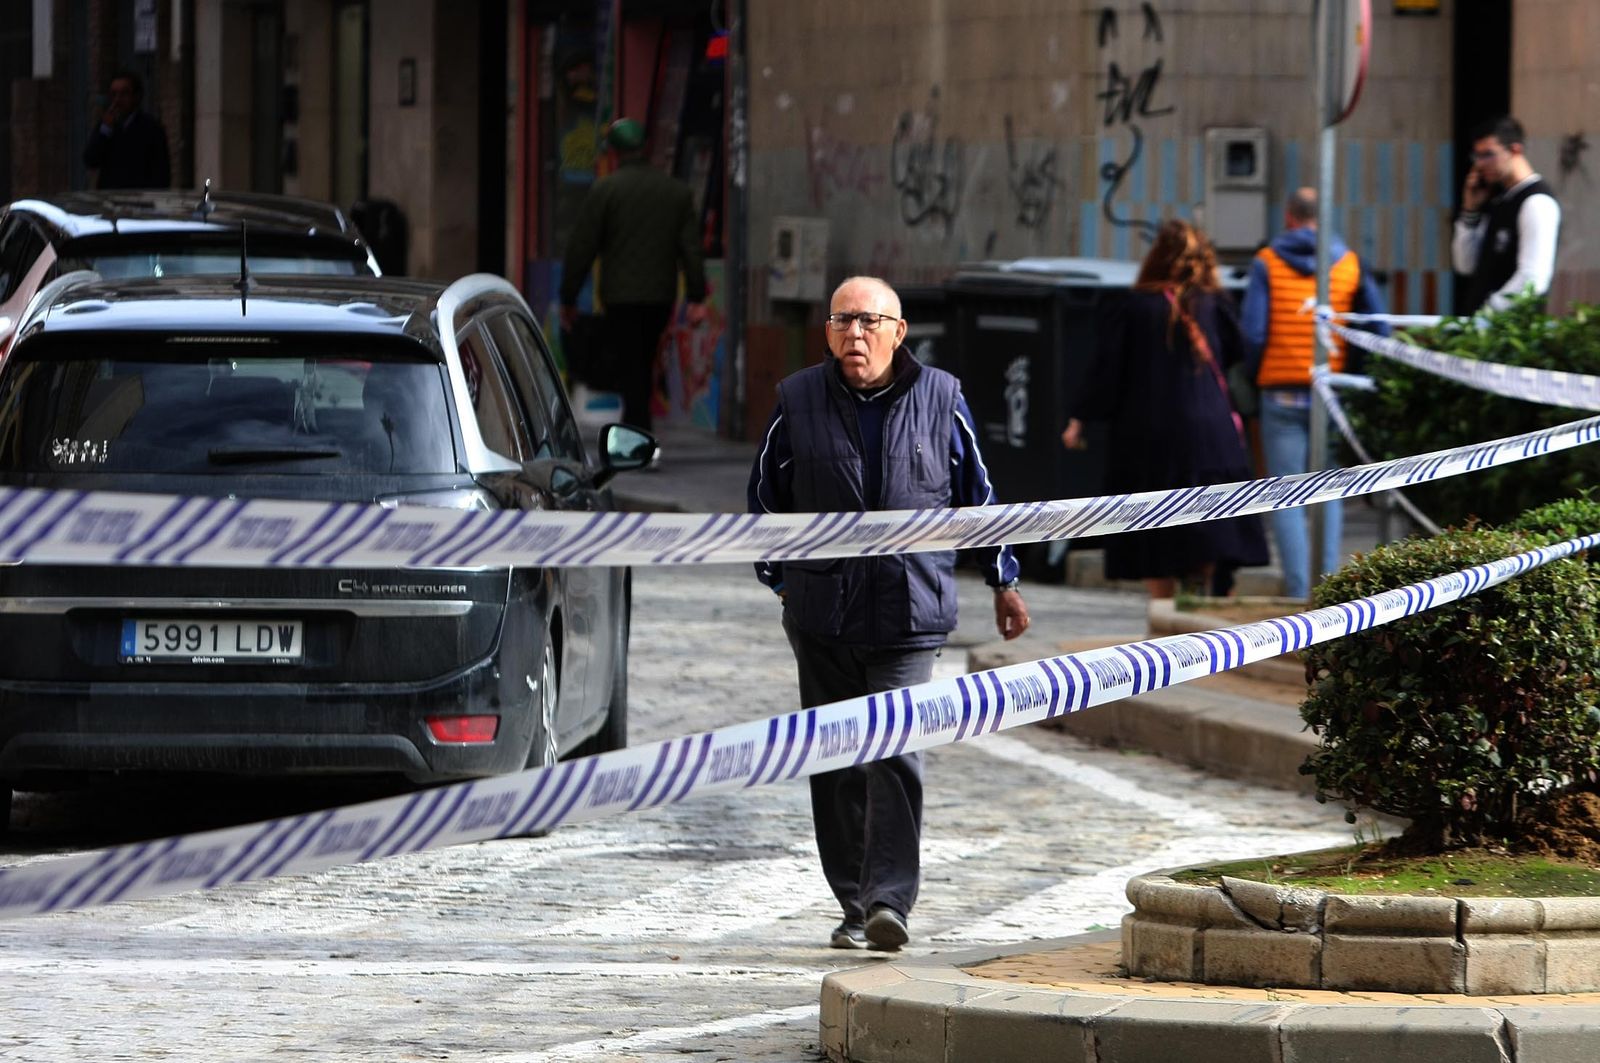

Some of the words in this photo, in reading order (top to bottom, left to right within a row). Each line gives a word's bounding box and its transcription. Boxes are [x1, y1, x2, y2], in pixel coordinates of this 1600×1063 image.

[338, 579, 368, 593] C4
[372, 584, 467, 594] SPACETOURER
[144, 623, 218, 652] 5991
[236, 624, 294, 653] LDW
